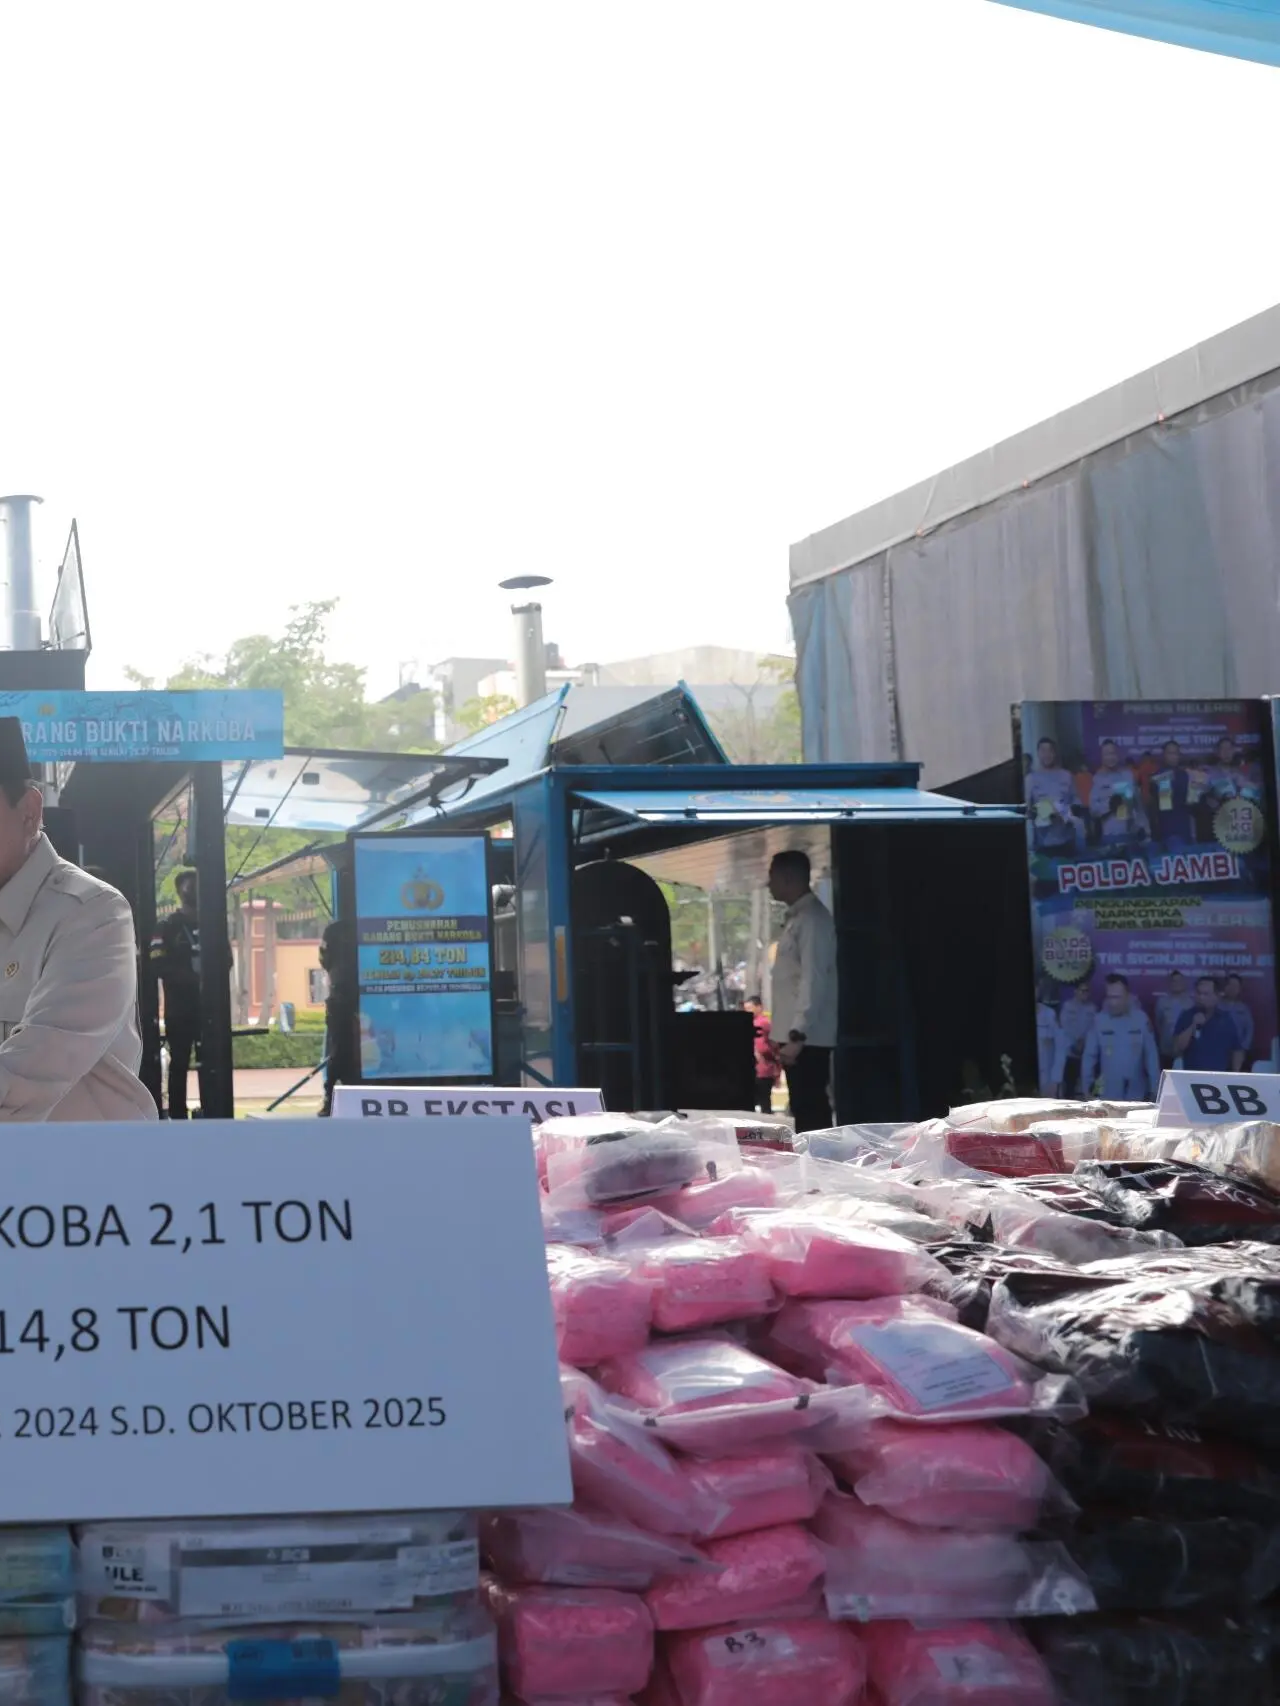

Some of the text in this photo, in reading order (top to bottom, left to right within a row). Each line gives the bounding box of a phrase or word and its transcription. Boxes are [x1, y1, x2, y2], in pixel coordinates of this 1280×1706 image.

[21, 721, 77, 743] RANG
[86, 720, 148, 743] BUKTI
[157, 719, 256, 742] NARKOBA
[1058, 852, 1241, 893] POLDA JAMBI
[1095, 909, 1183, 919] NARKOTIKA
[361, 1098, 577, 1125] BB EKSTASI
[1190, 1083, 1268, 1115] BB
[149, 1203, 226, 1253] 2,1
[242, 1200, 353, 1243] TON
[117, 1306, 230, 1350] TON
[14, 1407, 99, 1437] 2024
[111, 1406, 175, 1435] S.D.
[188, 1401, 352, 1433] OKTOBER
[363, 1397, 446, 1427] 2025
